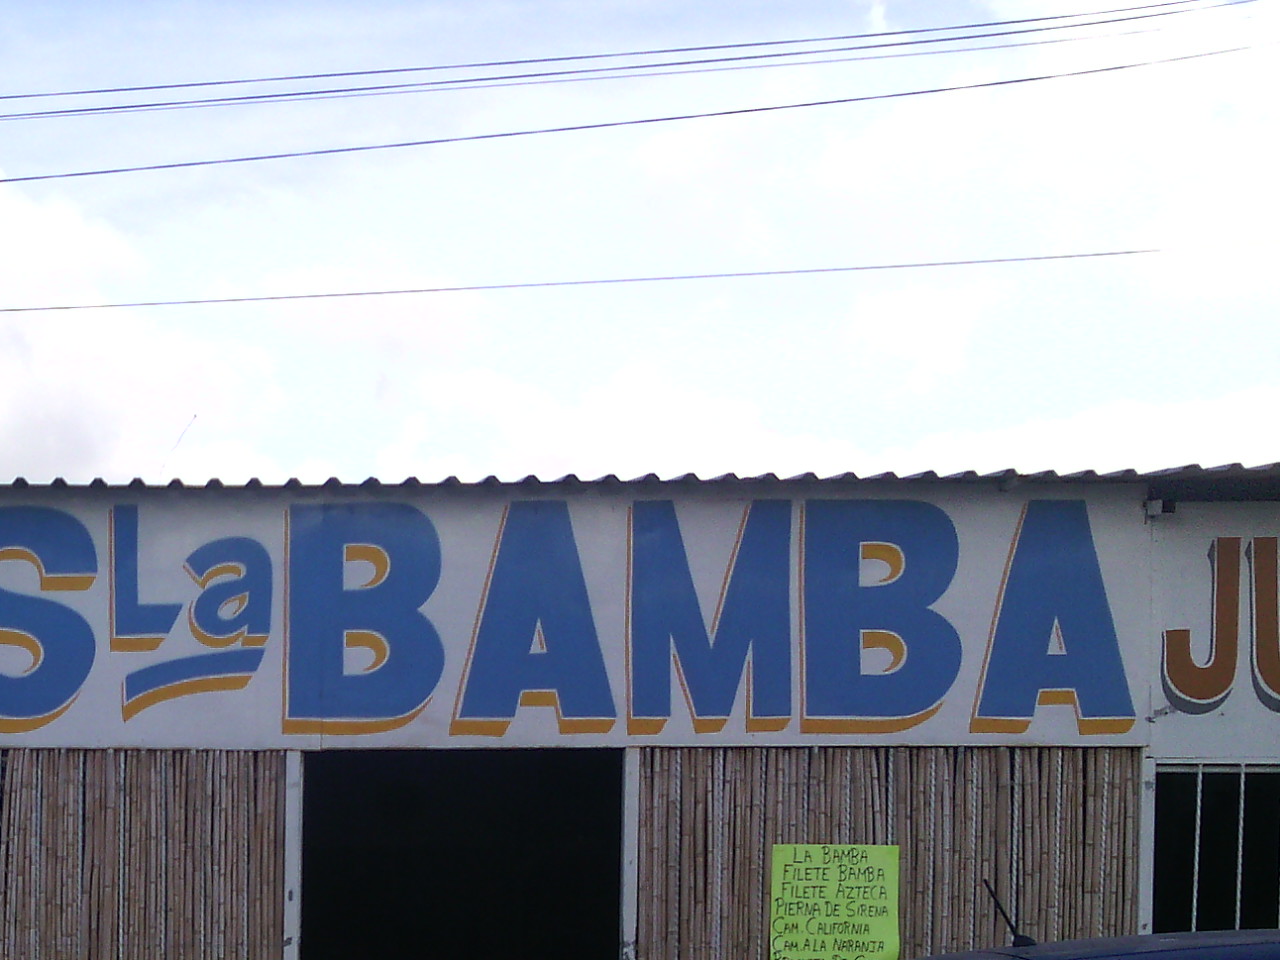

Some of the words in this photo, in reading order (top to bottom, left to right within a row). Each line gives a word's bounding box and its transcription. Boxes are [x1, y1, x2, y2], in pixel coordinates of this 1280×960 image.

[109, 504, 274, 653] La
[282, 499, 1137, 735] BAMBA
[793, 847, 813, 864] LA
[822, 845, 868, 865] BAMBA
[783, 864, 831, 882] FILETE
[837, 865, 885, 883] BAMBA
[781, 882, 827, 899] FILETE
[835, 883, 888, 900] AZTECA
[775, 897, 820, 917] PIERNA
[825, 901, 841, 917] DE
[806, 917, 870, 935] CALIFORNIA
[833, 938, 885, 953] NARANJA
